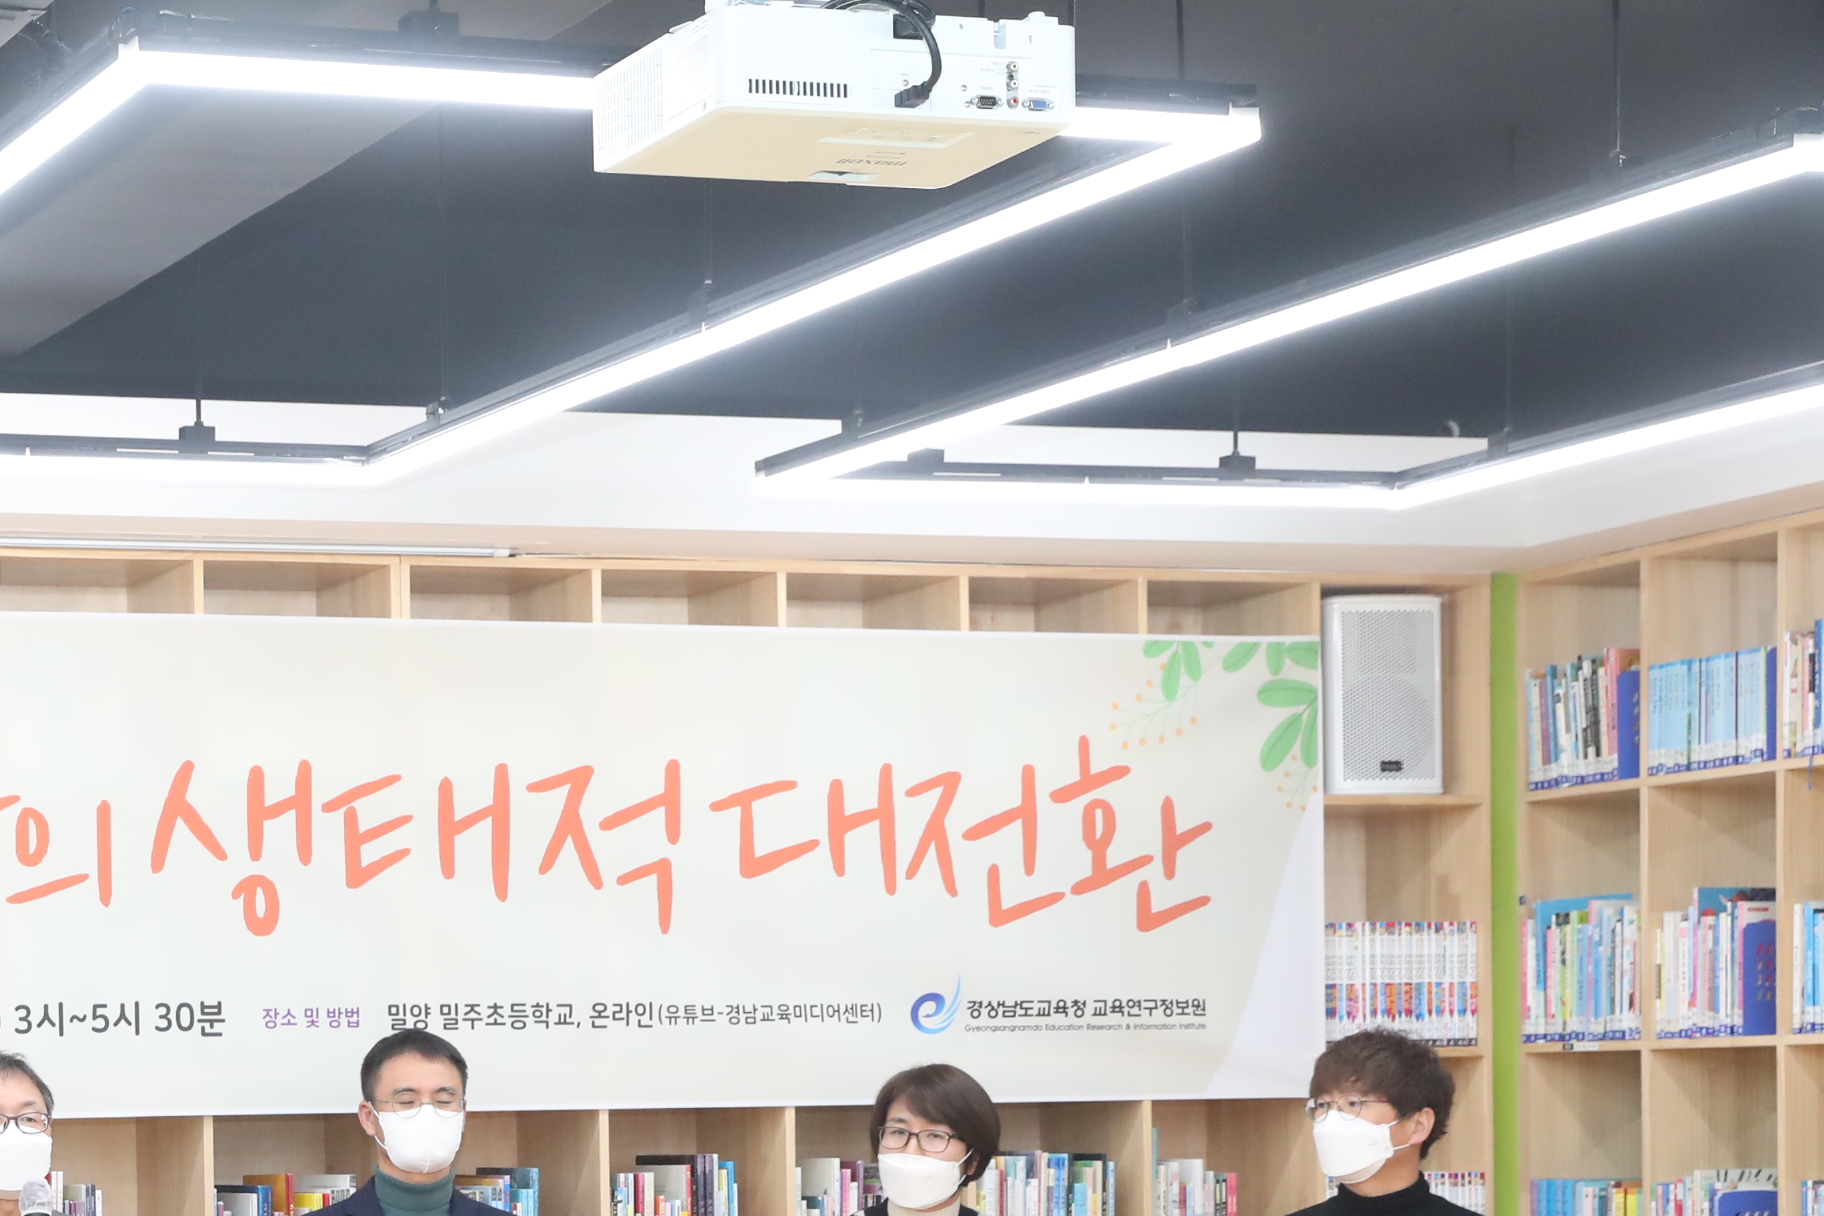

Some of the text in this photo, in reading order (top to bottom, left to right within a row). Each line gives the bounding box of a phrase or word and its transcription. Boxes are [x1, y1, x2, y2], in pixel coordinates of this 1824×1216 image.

[151, 760, 682, 938] 생태적
[709, 735, 1214, 934] 대전환
[14, 1000, 142, 1039] 3시~5시
[154, 1001, 228, 1039] 30분
[261, 1006, 362, 1031] 장소 및 방법
[387, 1002, 432, 1030] 밀양
[439, 1001, 582, 1032] 밀주초등학교,
[966, 998, 1207, 1020] 경상남도교육청 교육연구정보원
[1045, 1023, 1085, 1032] Education
[1086, 1022, 1124, 1032] Research
